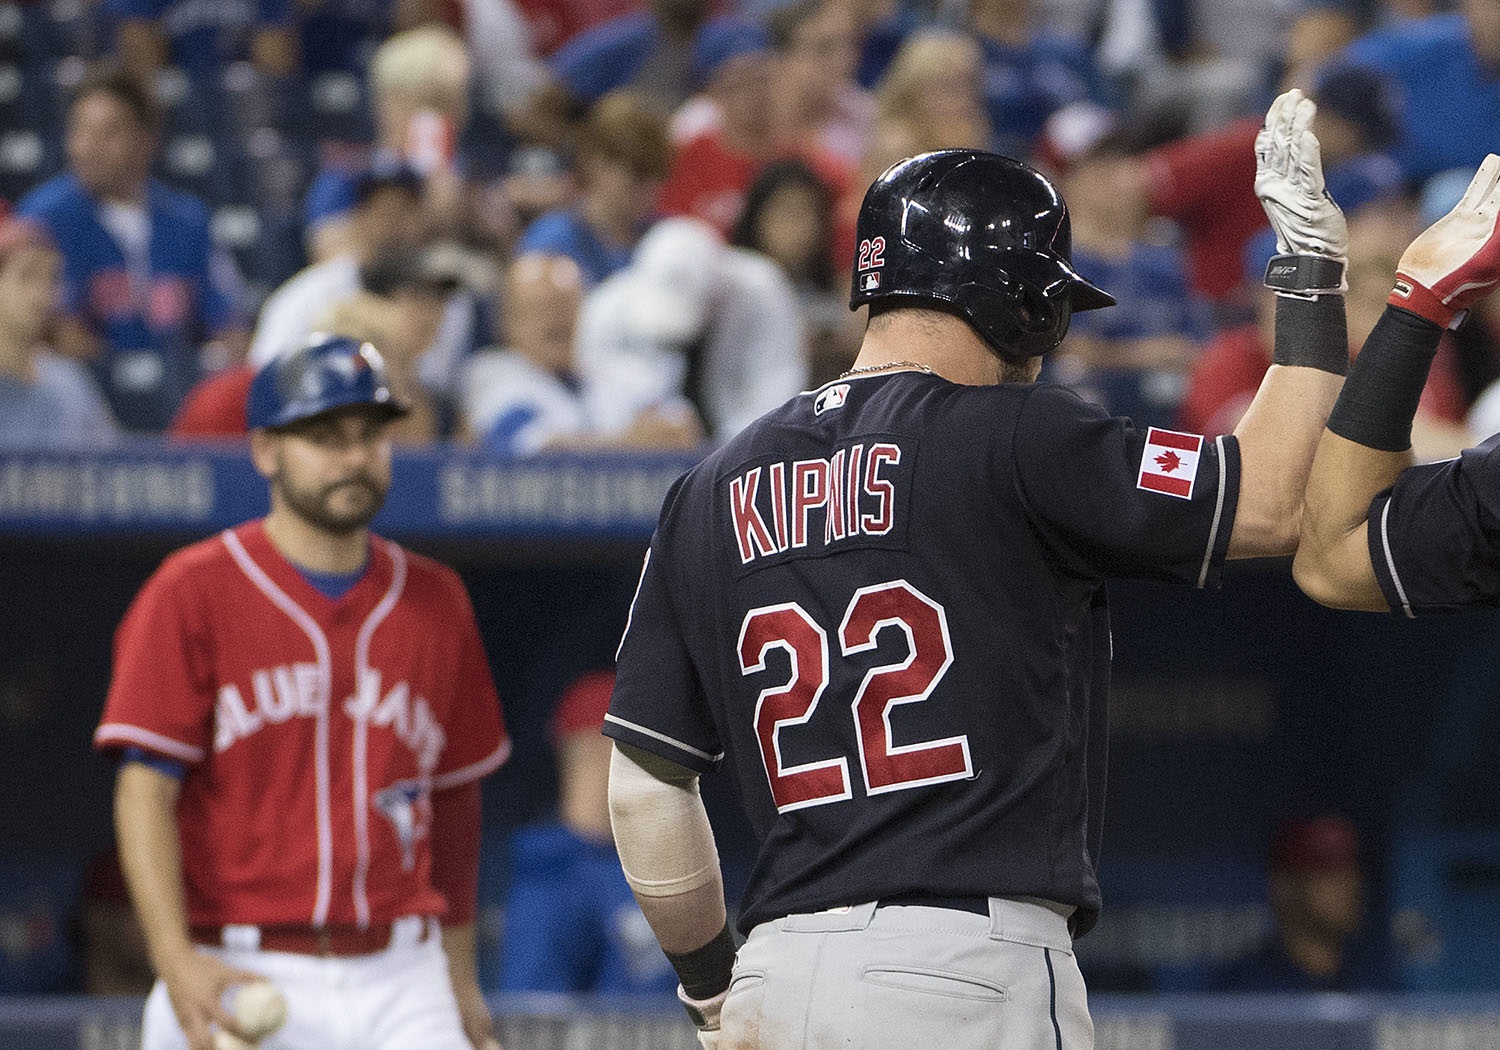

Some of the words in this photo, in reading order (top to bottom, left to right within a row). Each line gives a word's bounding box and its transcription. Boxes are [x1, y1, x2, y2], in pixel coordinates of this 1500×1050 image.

[858, 236, 886, 271] 22
[729, 443, 901, 564] KIPNIS
[737, 579, 974, 815] 22
